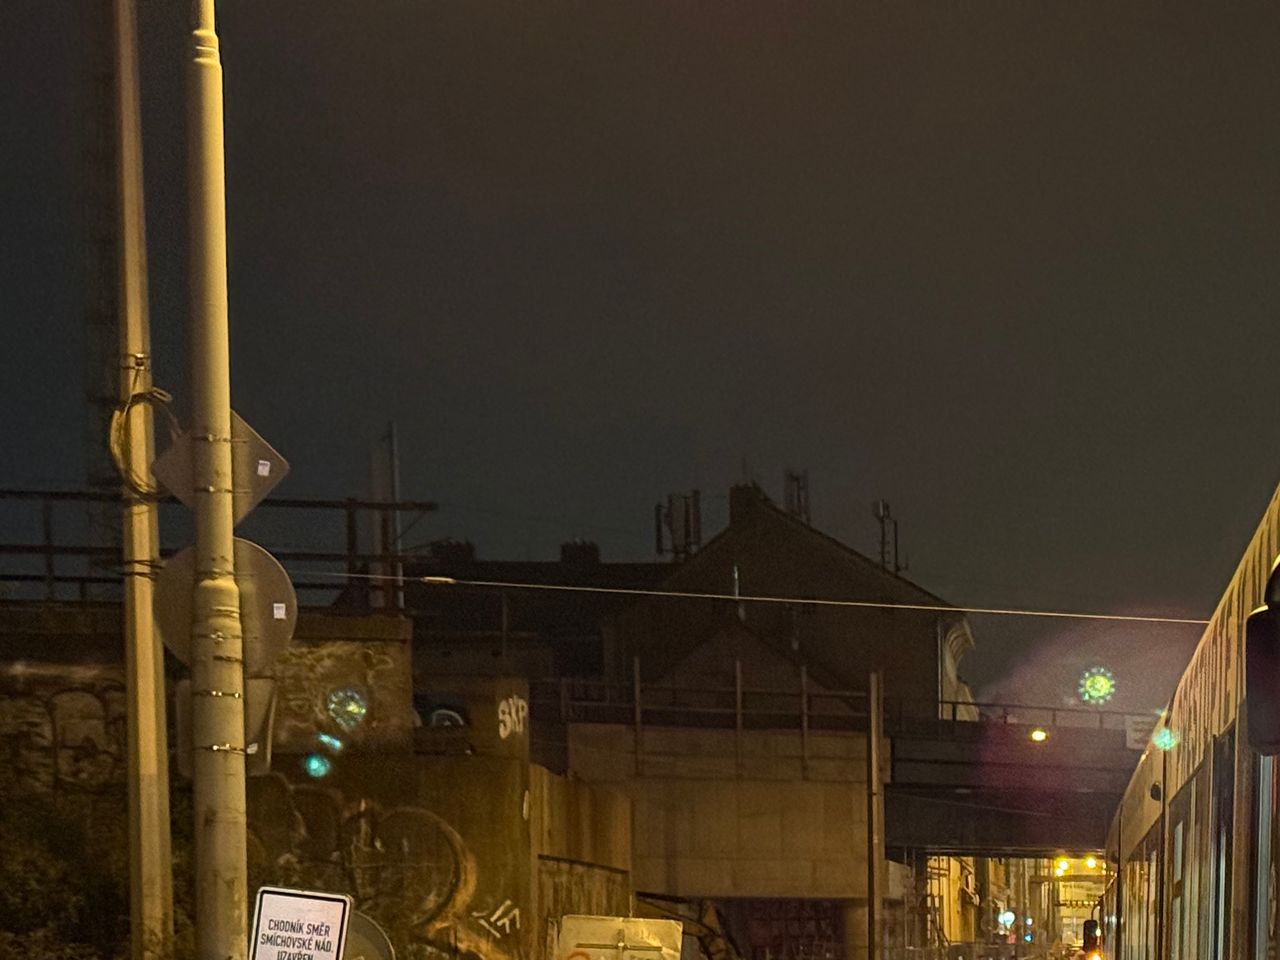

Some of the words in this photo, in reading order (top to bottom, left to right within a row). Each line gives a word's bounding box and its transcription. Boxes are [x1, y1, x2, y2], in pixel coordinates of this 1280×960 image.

[268, 919, 304, 934] CHODNÍK
[306, 923, 331, 938] SMĚR
[260, 933, 313, 951] SMÍCHOVSKÉ
[314, 938, 334, 954] NÁD.
